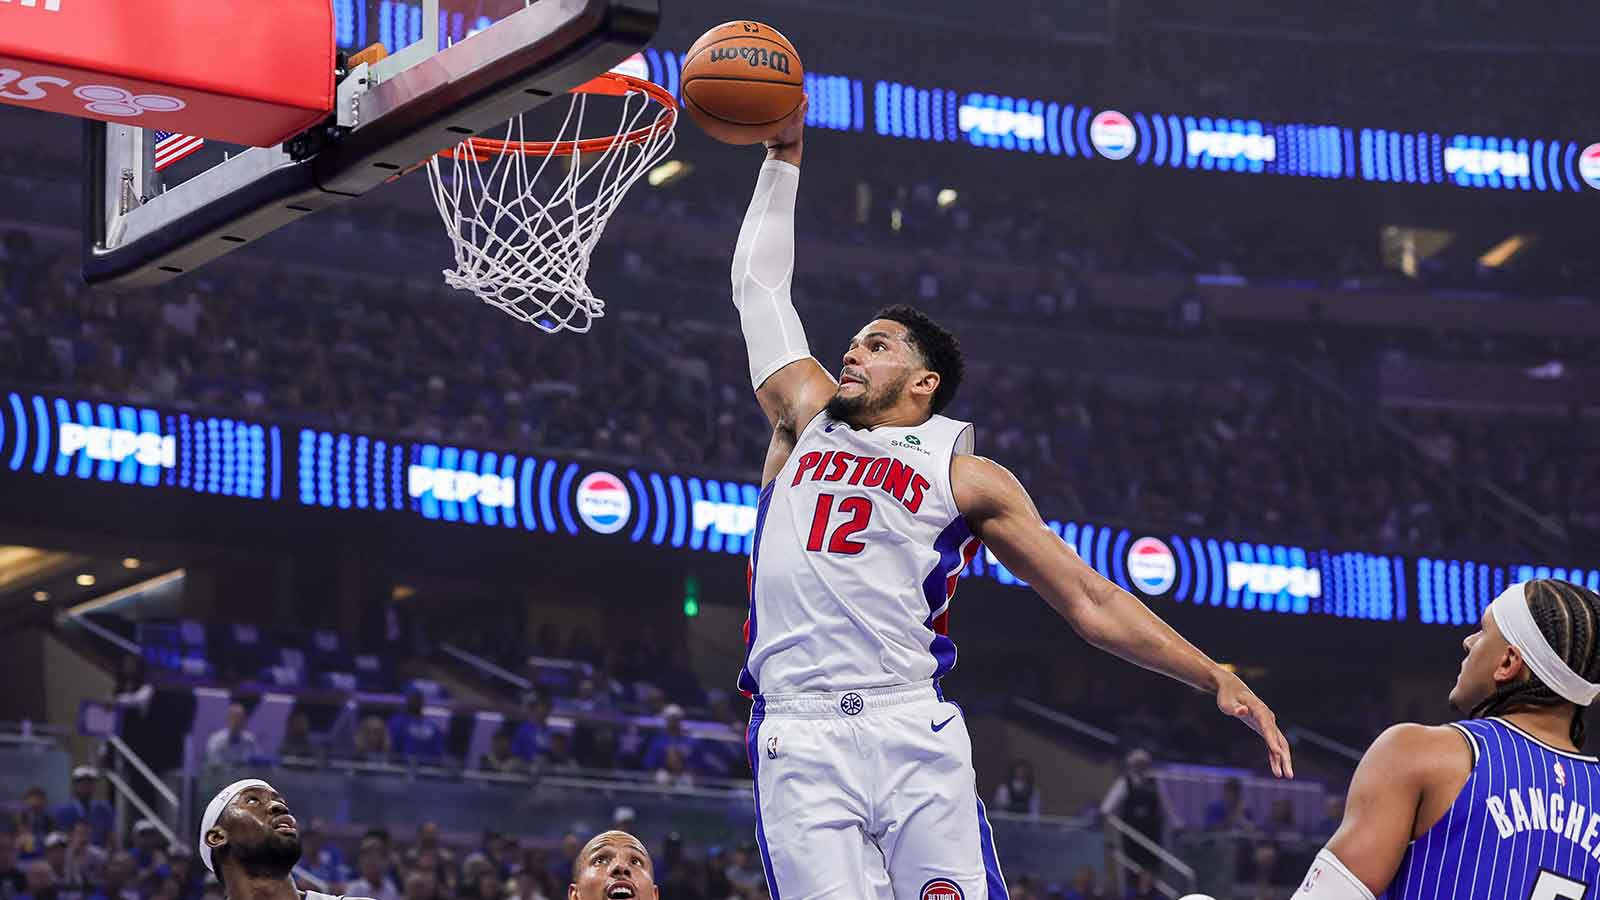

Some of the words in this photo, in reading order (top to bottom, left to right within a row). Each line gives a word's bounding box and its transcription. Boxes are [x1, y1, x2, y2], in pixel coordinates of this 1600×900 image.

[710, 46, 790, 75] Wilson
[958, 105, 1044, 140] PEPSI
[1187, 129, 1276, 162] PEPSI
[1444, 147, 1530, 178] PEPSI
[60, 422, 176, 468] PEPSI
[408, 464, 515, 508] PEPSI
[791, 451, 931, 515] PISTONS
[693, 499, 757, 537] PEP
[806, 493, 873, 556] 12
[1227, 561, 1321, 598] PEPSI
[1486, 787, 1600, 863] BANCHE
